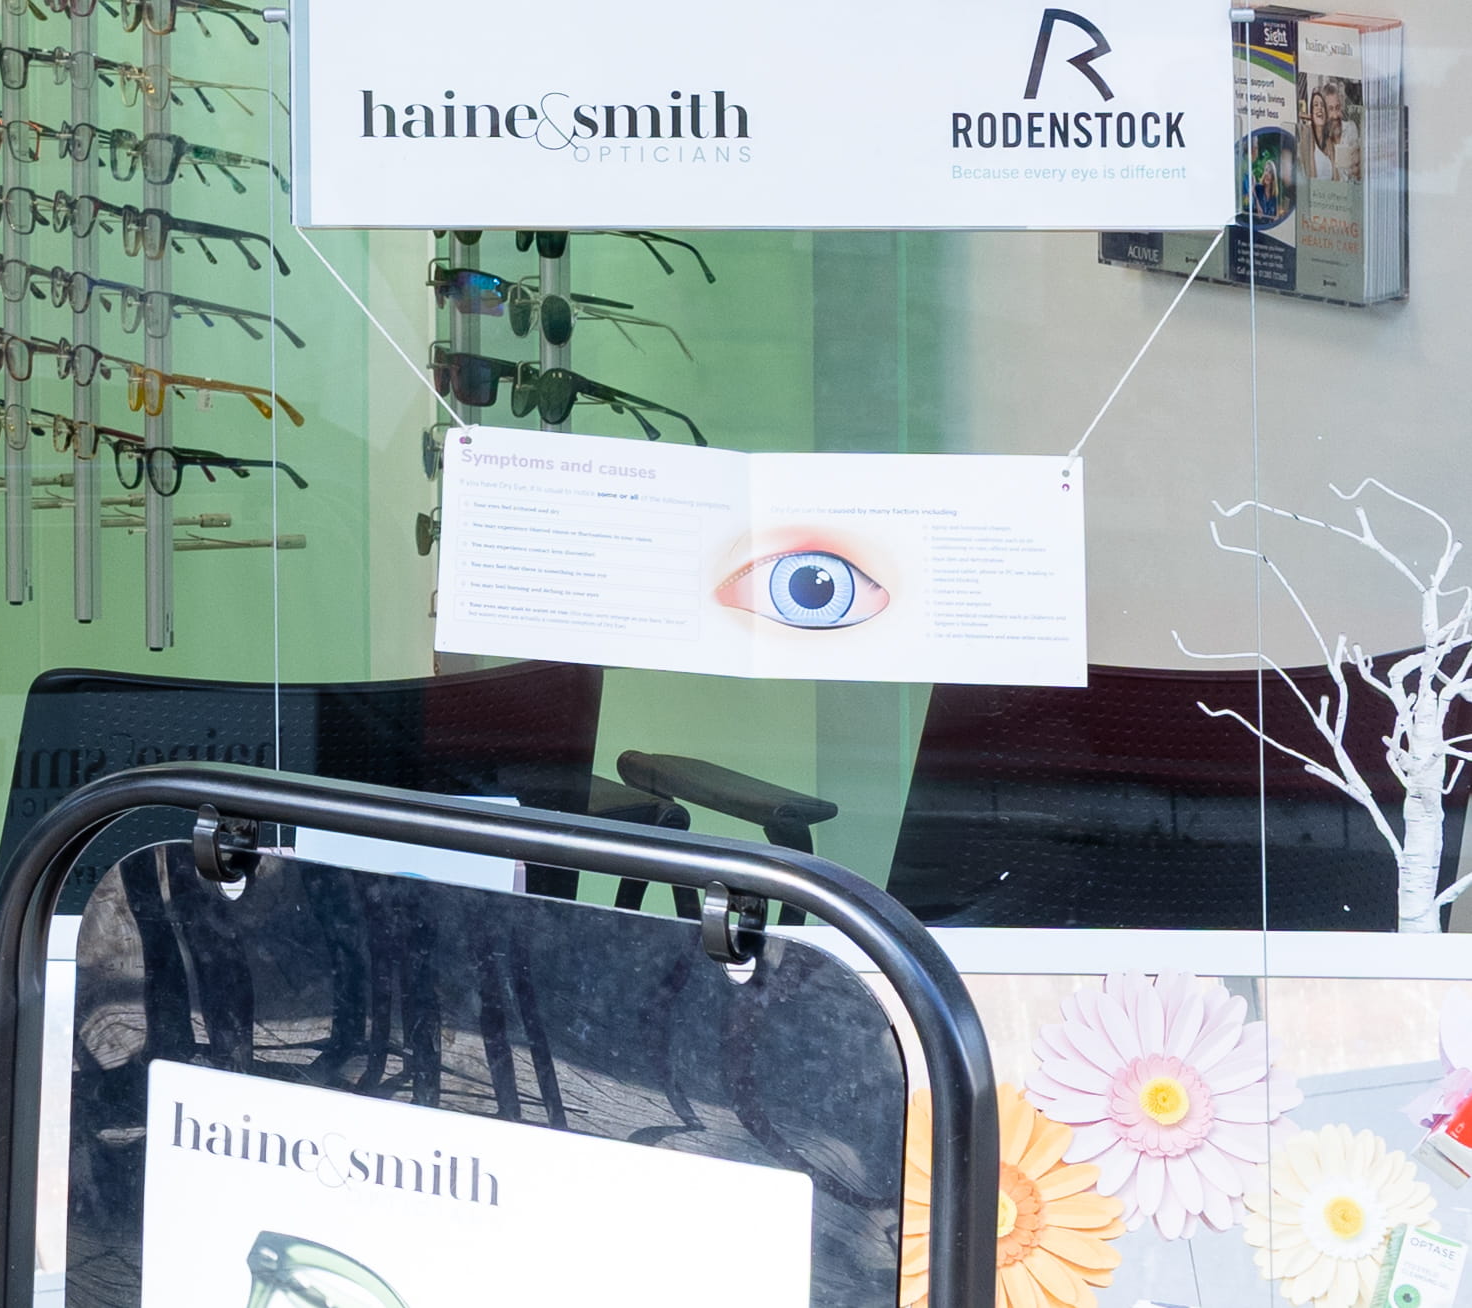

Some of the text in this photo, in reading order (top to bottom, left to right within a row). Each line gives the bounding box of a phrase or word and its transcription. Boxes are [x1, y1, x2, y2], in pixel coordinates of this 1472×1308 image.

[360, 89, 750, 150] haine&smith
[952, 111, 1186, 149] RODENSTOCK
[573, 144, 753, 164] OPTICIANS
[951, 164, 1187, 183] Because every eye is different
[461, 448, 657, 480] Symptoms and causes
